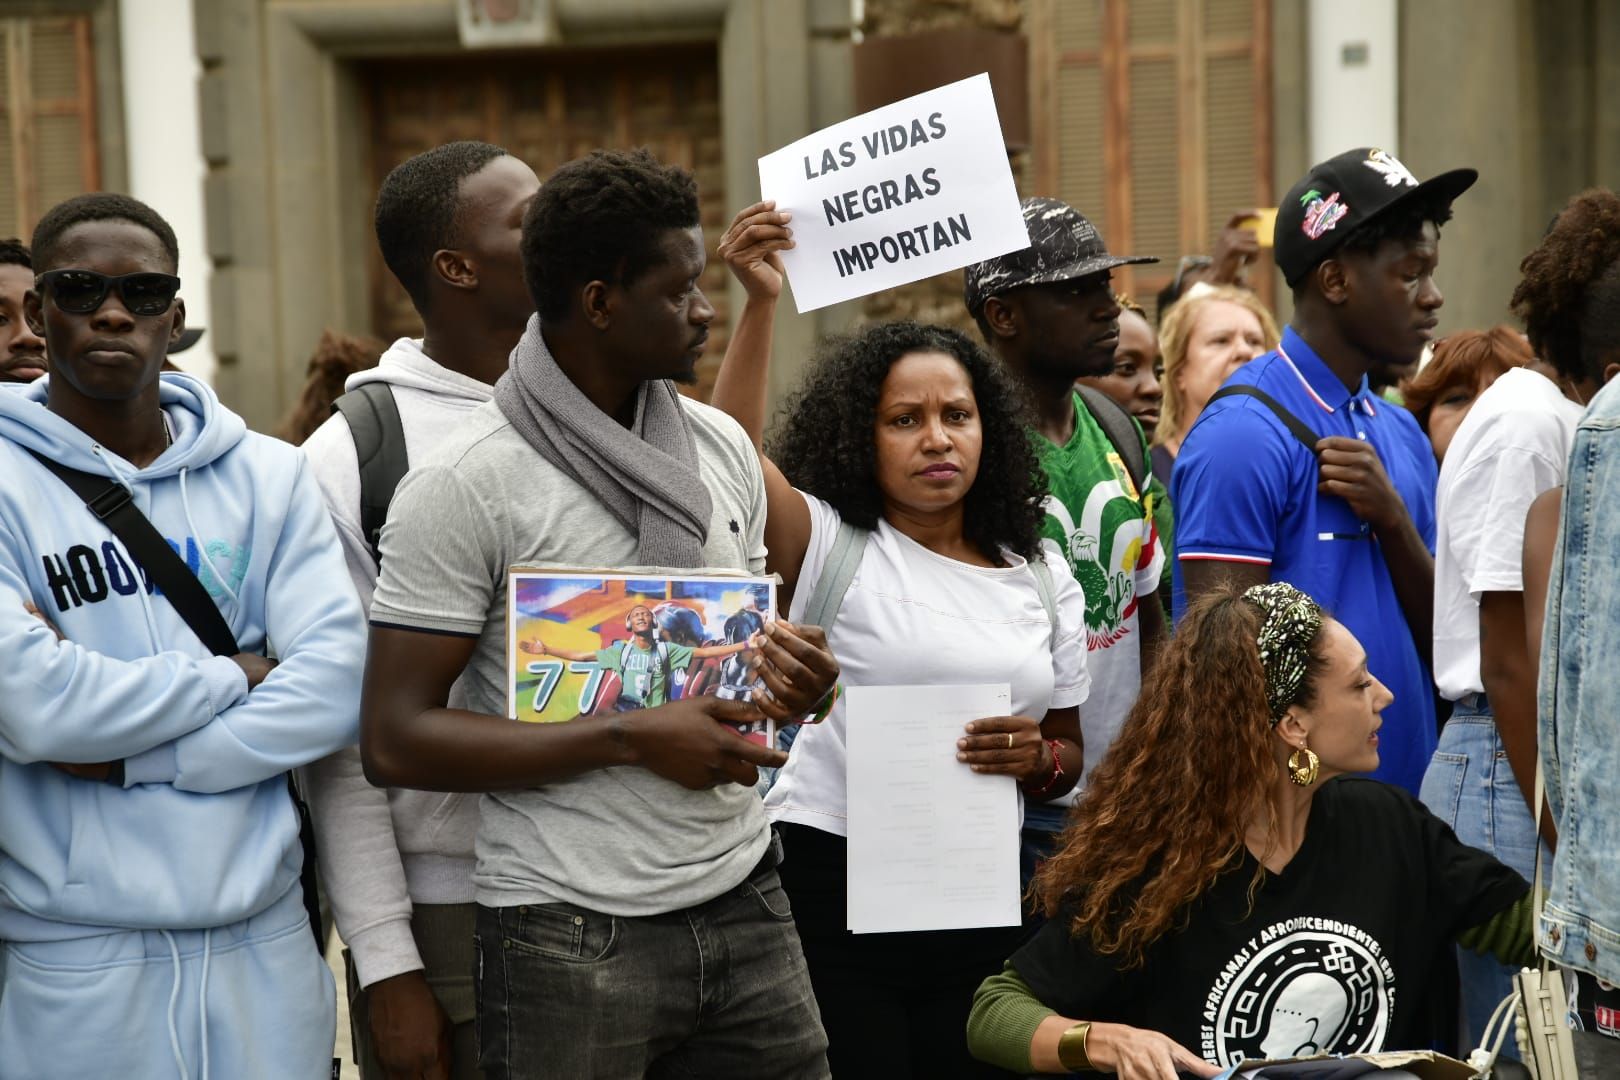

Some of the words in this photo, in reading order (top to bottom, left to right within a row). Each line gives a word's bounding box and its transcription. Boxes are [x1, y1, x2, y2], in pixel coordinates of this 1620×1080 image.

[804, 141, 856, 180] LAS
[862, 112, 947, 159] VIDAS
[822, 167, 941, 227] NEGRAS
[832, 213, 972, 278] IMPORTAN
[1203, 947, 1251, 1022] AFRICANAS
[1248, 938, 1259, 950] Y
